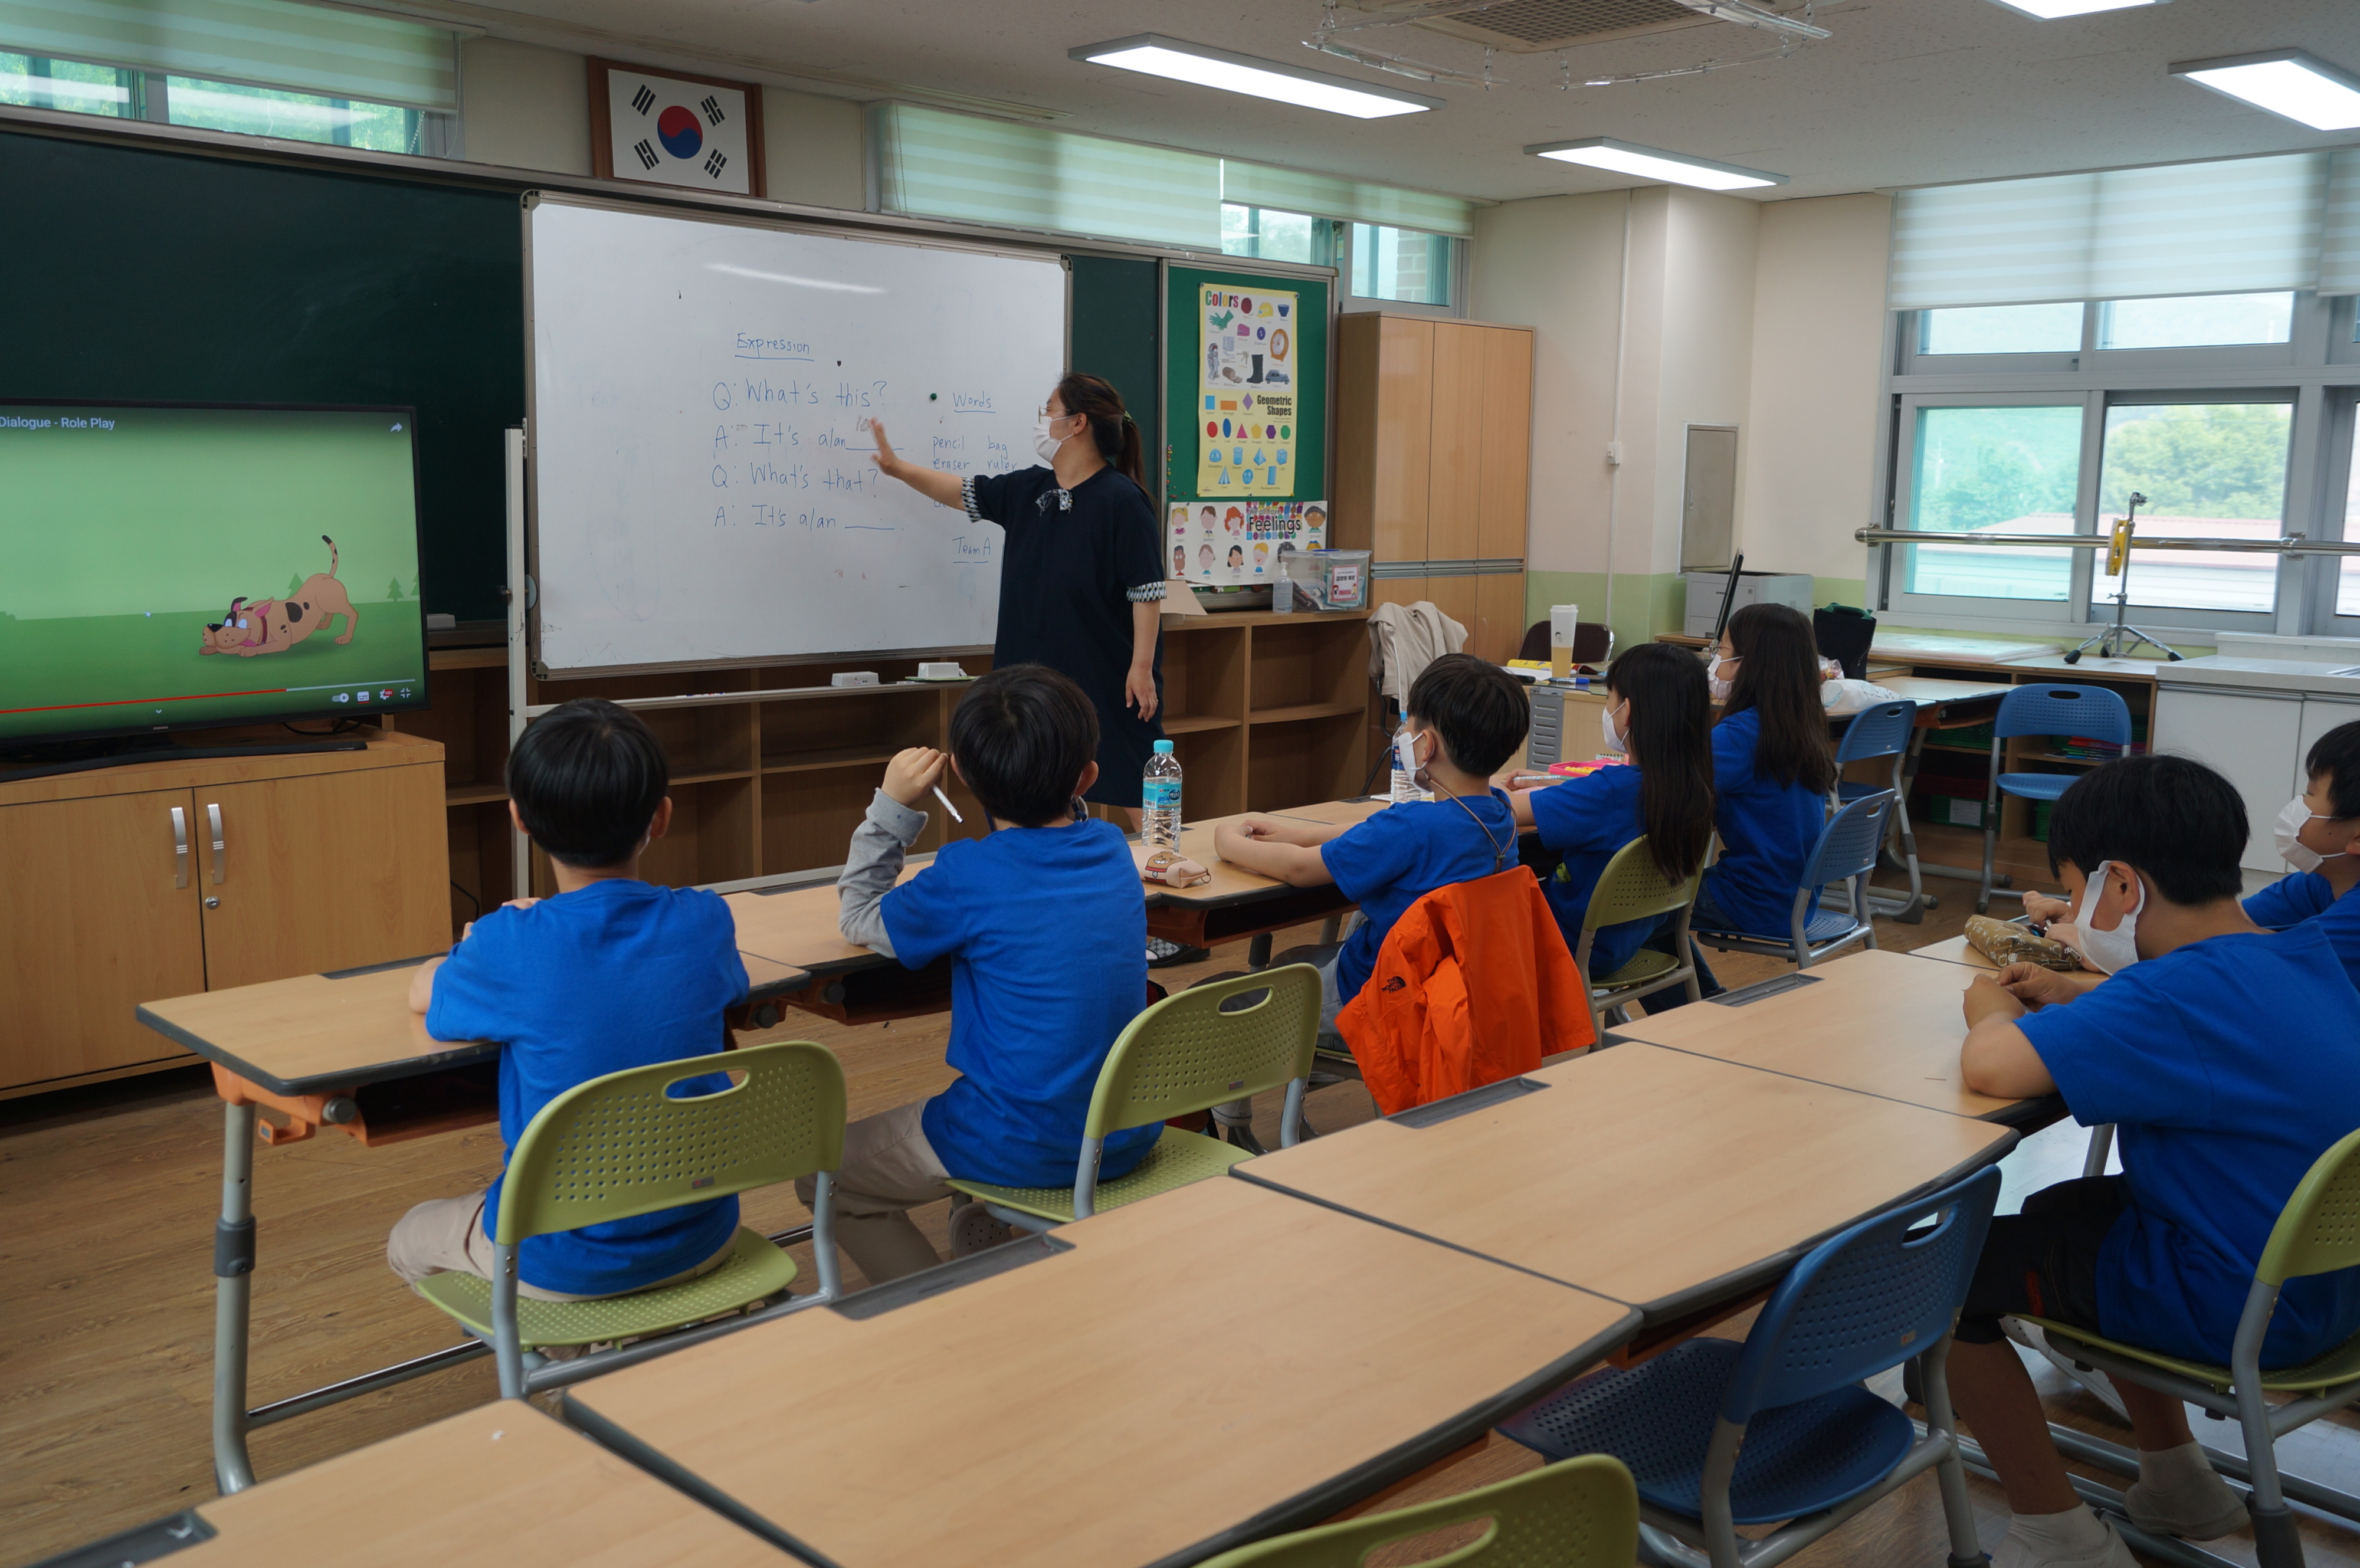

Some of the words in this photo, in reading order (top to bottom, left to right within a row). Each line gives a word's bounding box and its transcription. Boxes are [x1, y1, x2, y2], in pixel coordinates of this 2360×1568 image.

[1205, 290, 1239, 308] Colors
[737, 332, 810, 358] Expression
[713, 382, 738, 411] Q:
[746, 378, 819, 405] What's
[835, 380, 887, 408] this?
[953, 391, 992, 409] Words
[1257, 395, 1292, 405] Geometric
[1267, 406, 1292, 416] Shapes
[0, 416, 51, 429] Dialogue
[61, 417, 87, 428] Role
[90, 418, 115, 431] Play
[753, 422, 799, 445] It's
[933, 435, 965, 458] pencil
[988, 435, 1008, 460] bag
[933, 458, 971, 470] eraser
[987, 455, 1018, 472] ruler
[750, 462, 809, 489] What's
[823, 469, 879, 498] that?
[752, 504, 786, 527] It's
[1249, 516, 1302, 534] Feelings
[952, 536, 981, 555] Team
[982, 537, 991, 556] A
